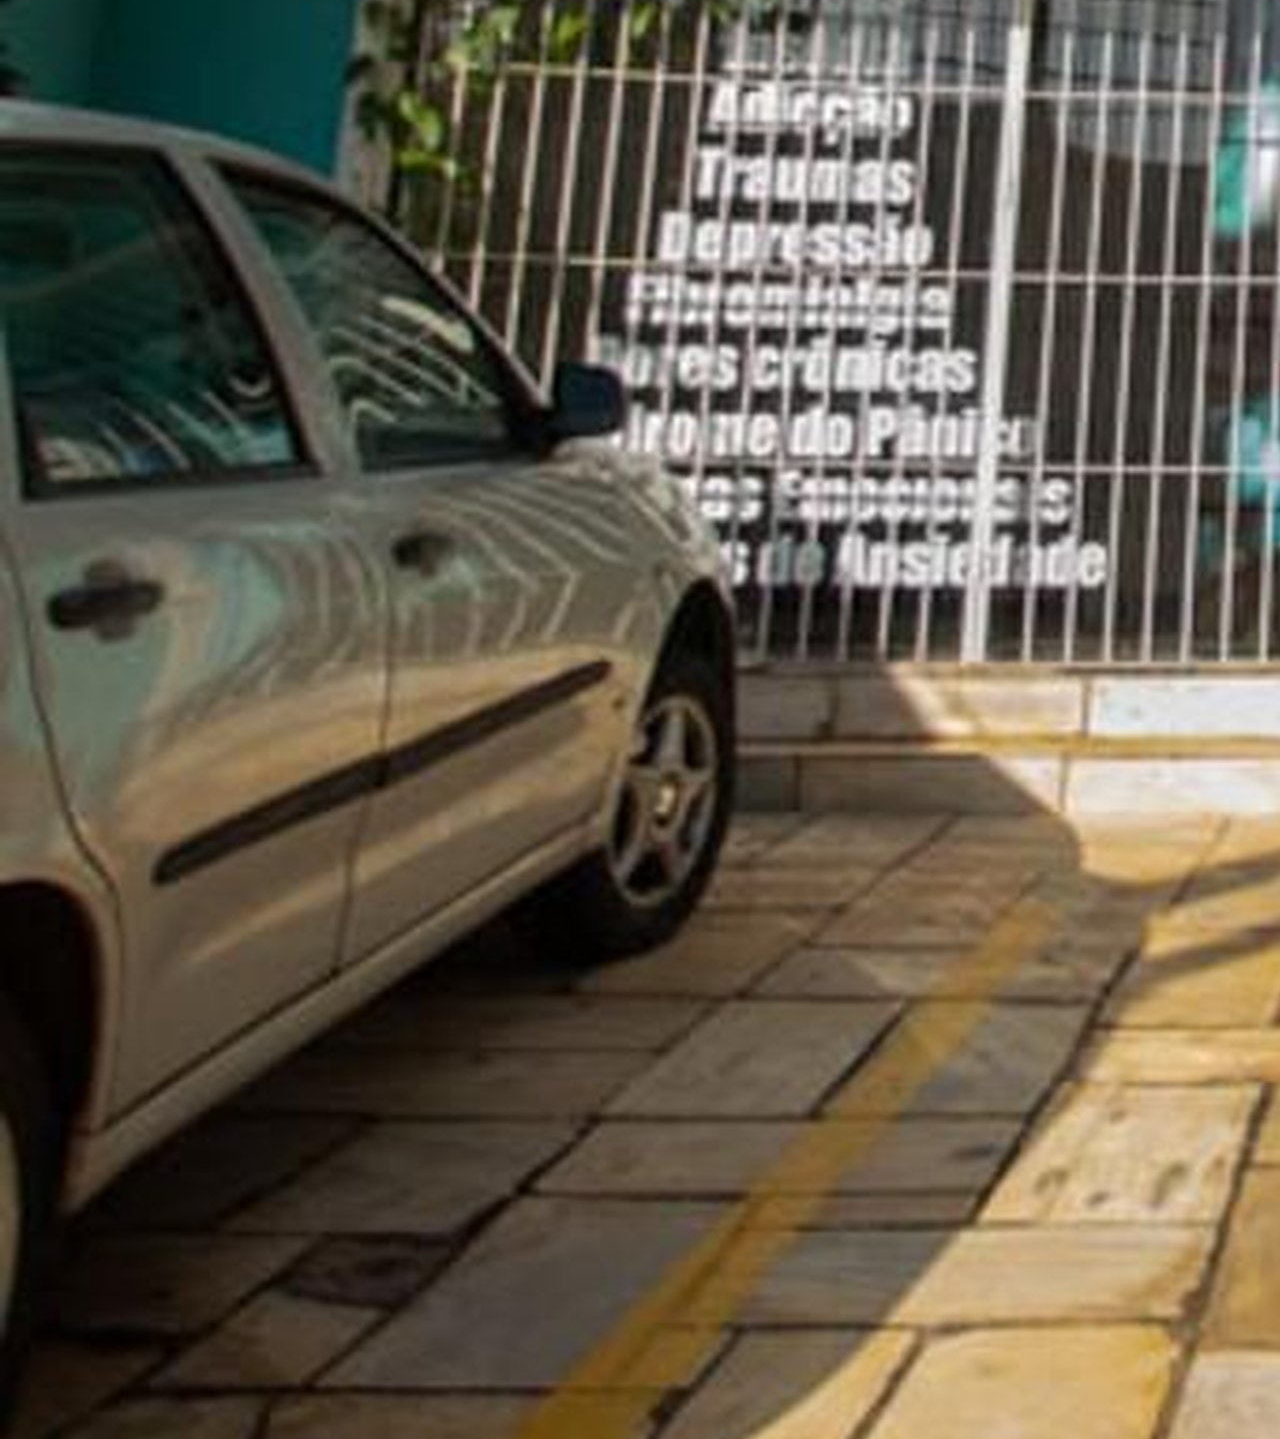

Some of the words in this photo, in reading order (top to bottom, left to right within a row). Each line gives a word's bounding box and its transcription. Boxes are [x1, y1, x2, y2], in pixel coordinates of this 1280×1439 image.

[697, 146, 917, 203] Traumas
[657, 211, 934, 268] Depressão
[868, 406, 1037, 458] Pânio
